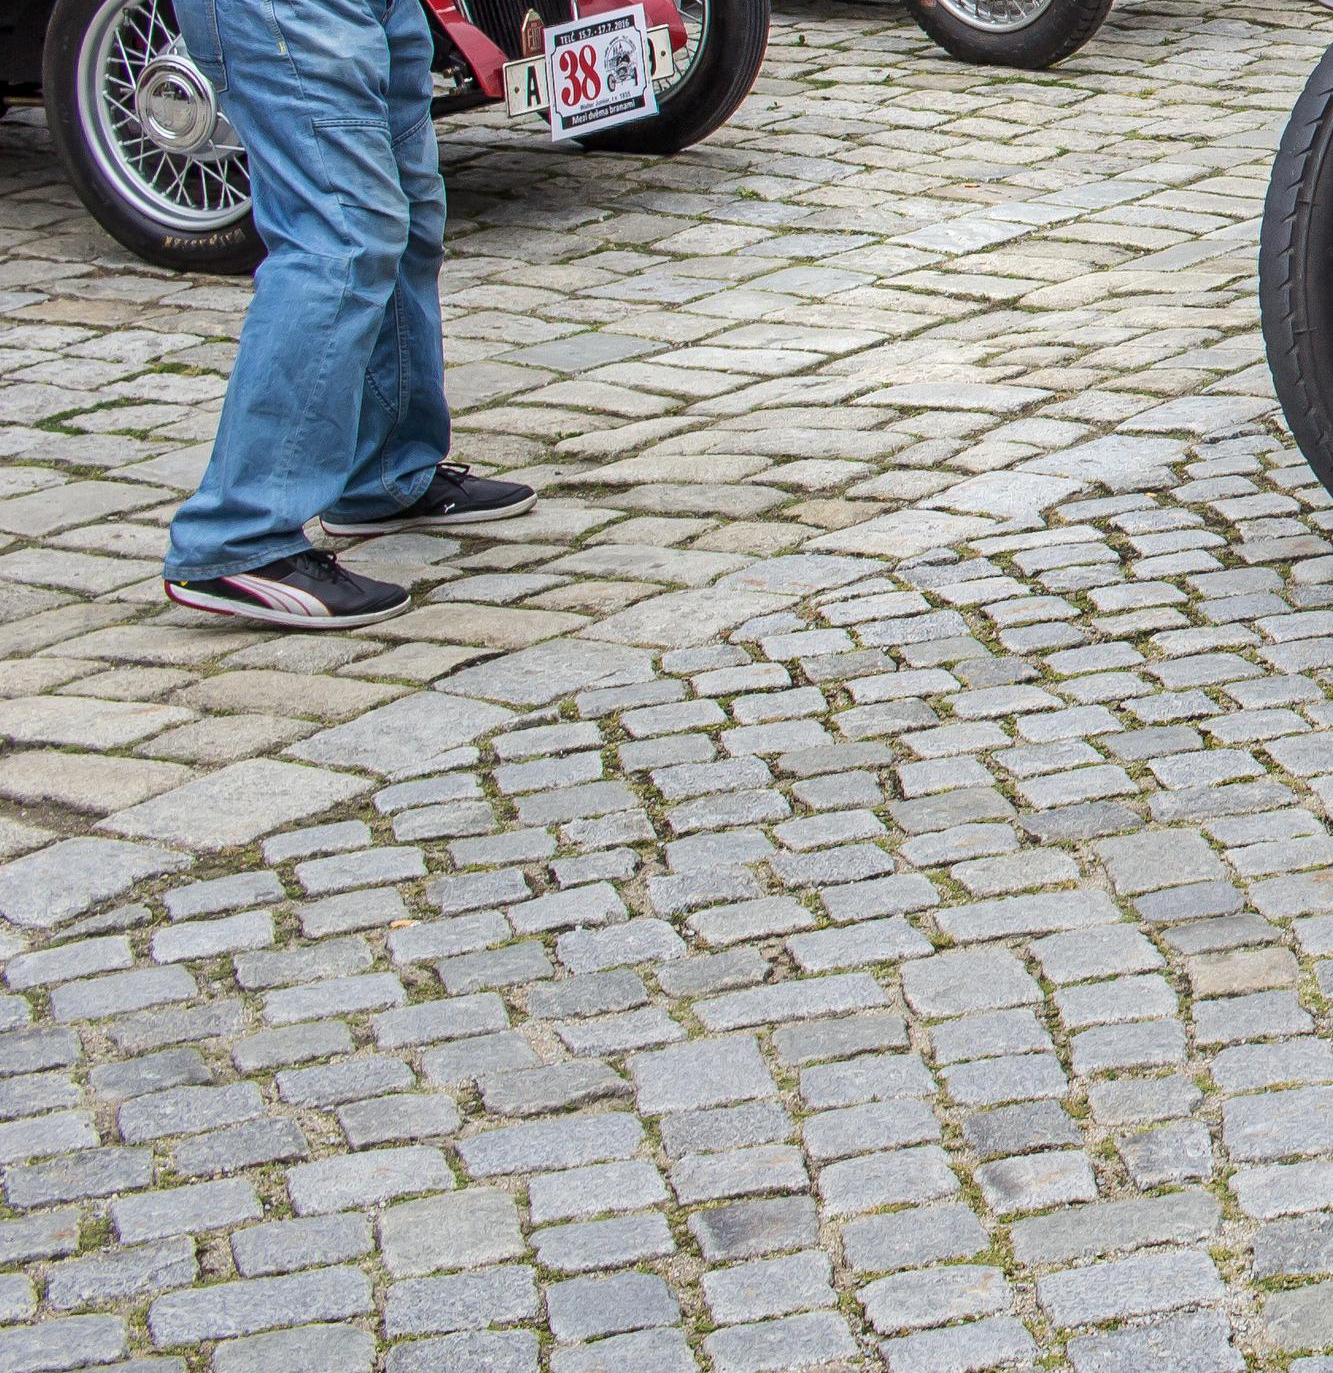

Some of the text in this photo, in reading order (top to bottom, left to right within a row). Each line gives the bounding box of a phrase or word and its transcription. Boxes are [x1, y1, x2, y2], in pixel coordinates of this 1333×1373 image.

[526, 65, 541, 107] A
[559, 44, 602, 107] 38
[572, 112, 588, 125] Mezi
